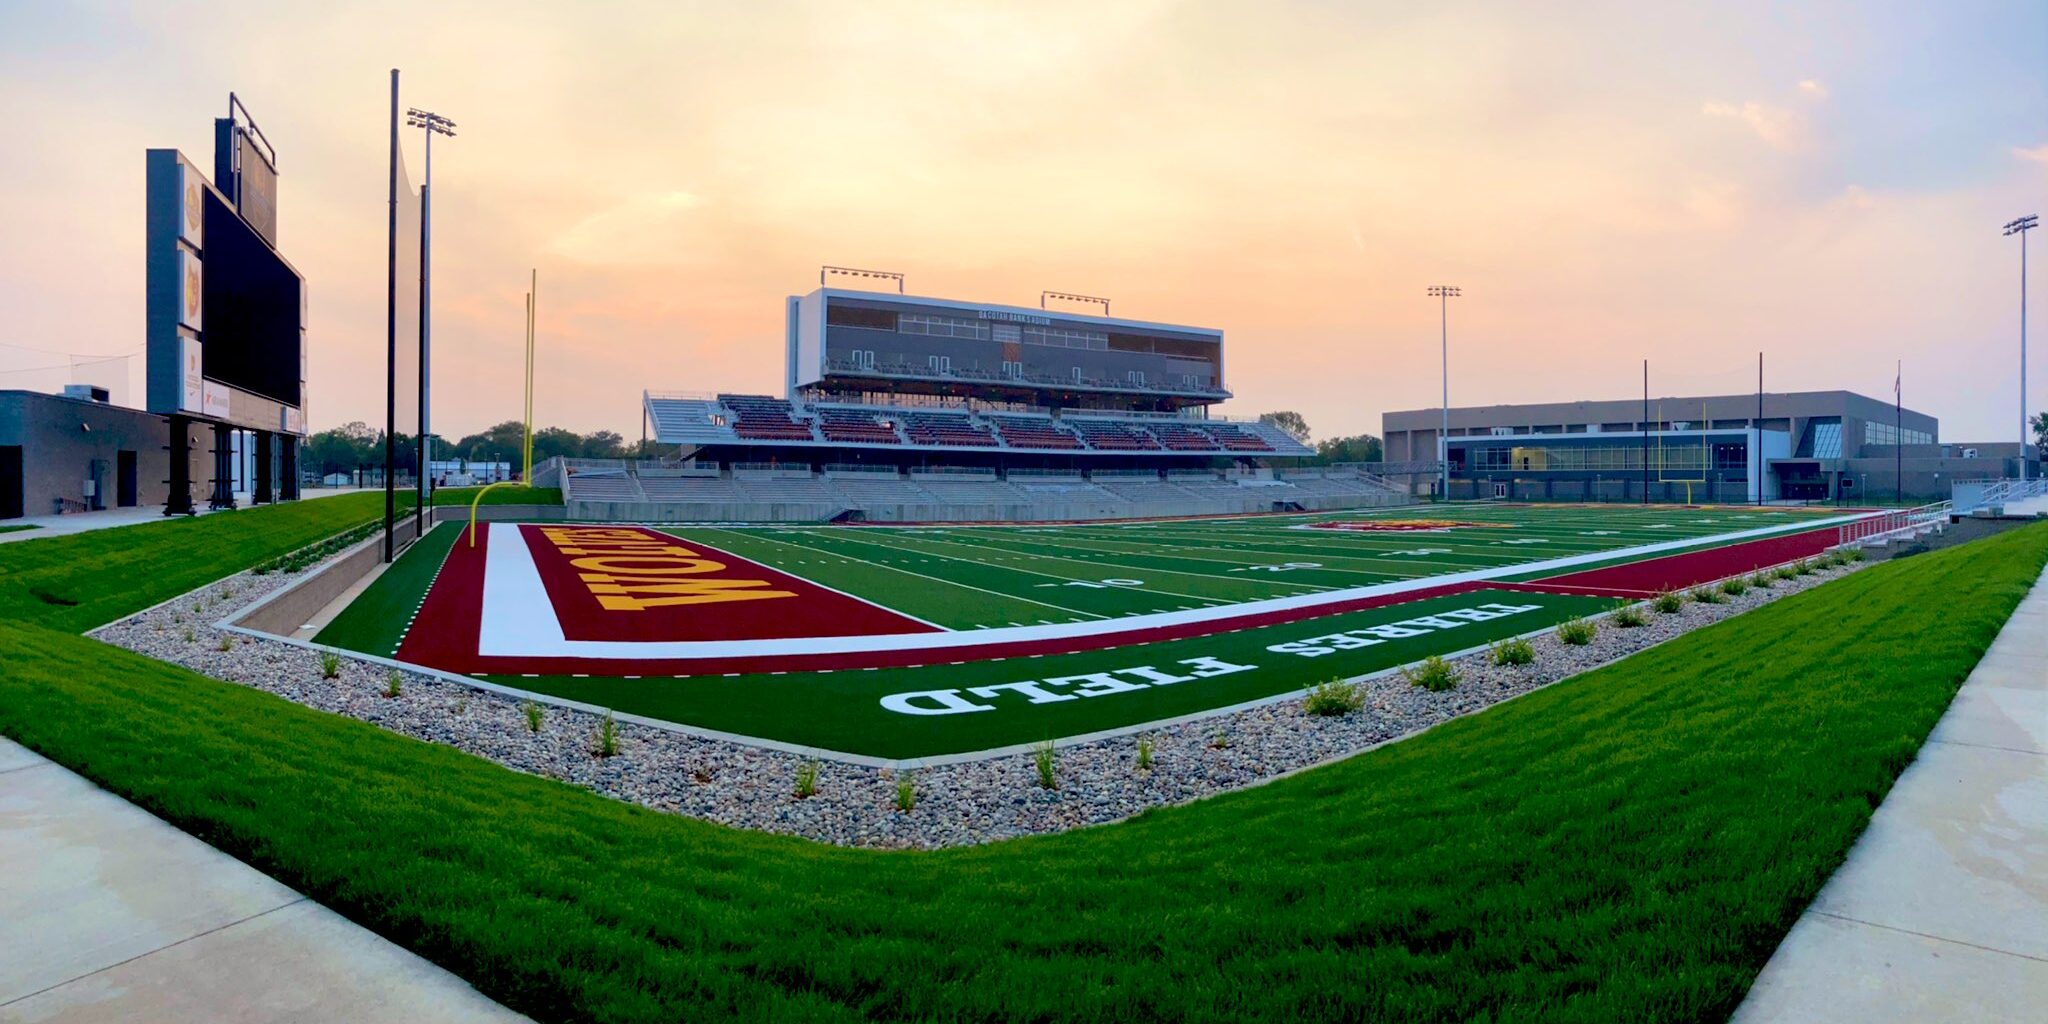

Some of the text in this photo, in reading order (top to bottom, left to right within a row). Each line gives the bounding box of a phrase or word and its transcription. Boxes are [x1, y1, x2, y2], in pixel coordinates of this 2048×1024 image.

[979, 311, 1008, 320] DACOTAH
[1009, 313, 1025, 322] BANK
[539, 528, 799, 611] WOLVES
[1248, 562, 1323, 572] 20
[1062, 578, 1144, 588] 10
[879, 603, 1544, 715] THARES FIELD
